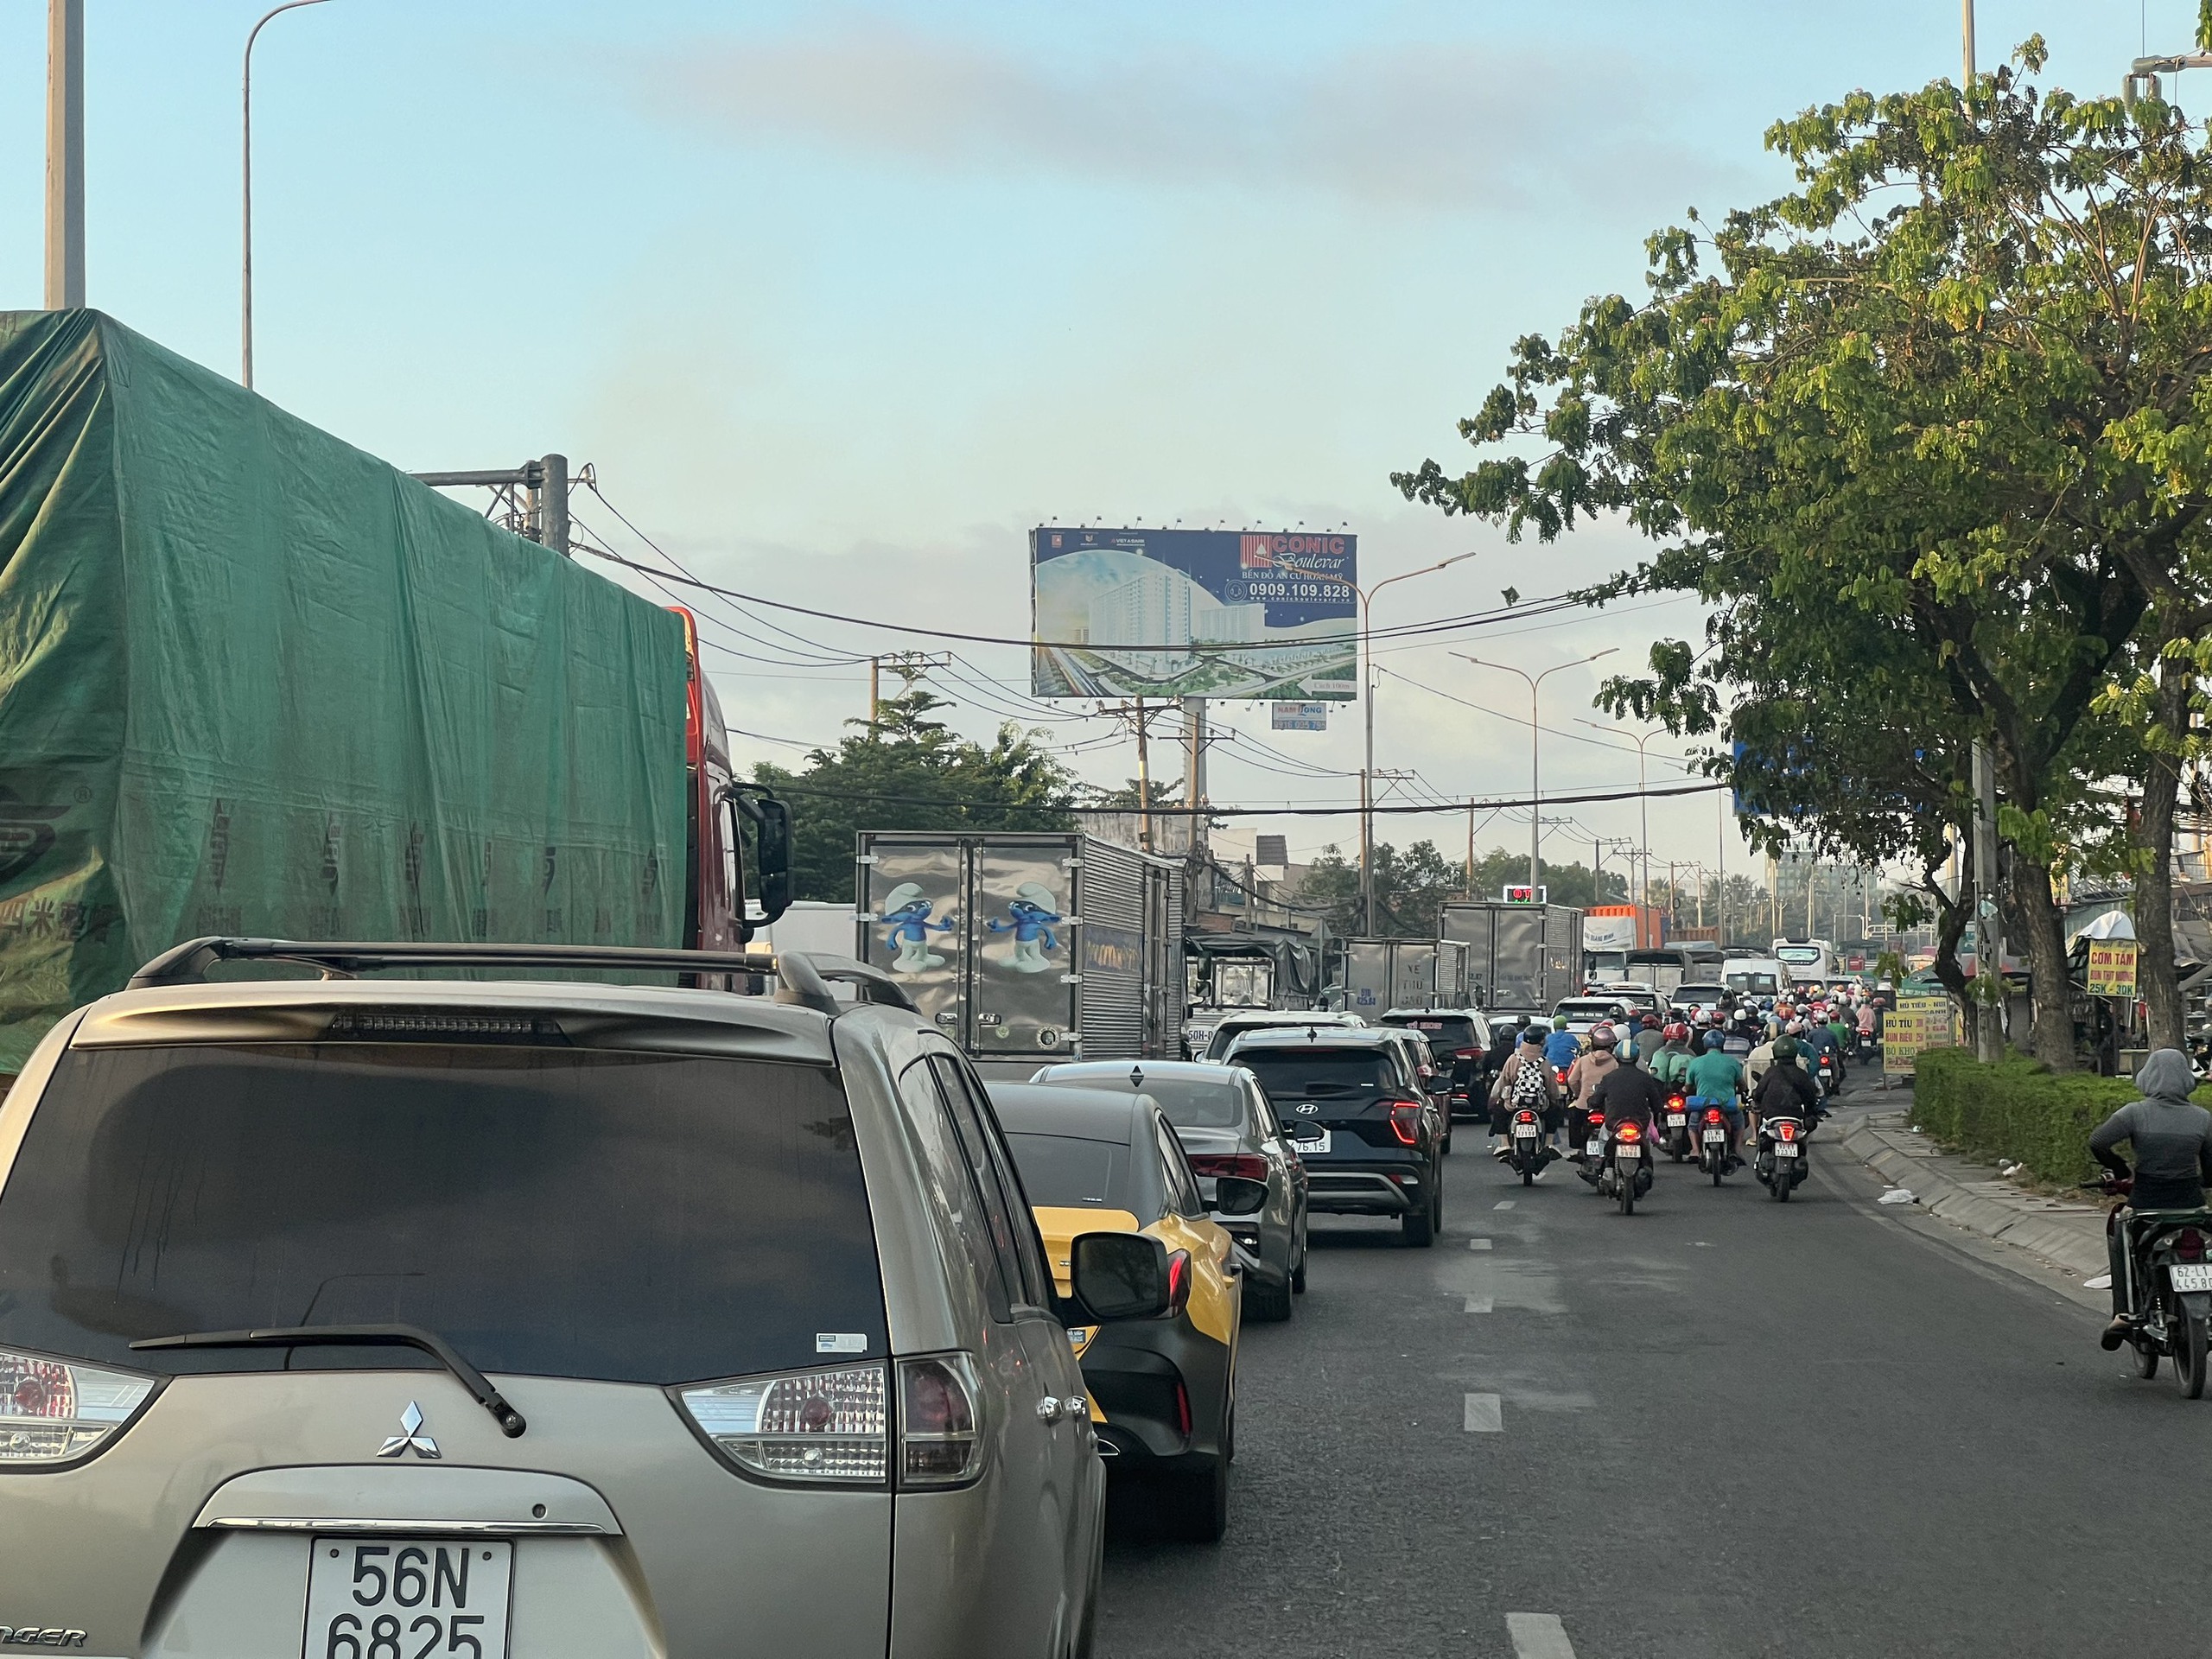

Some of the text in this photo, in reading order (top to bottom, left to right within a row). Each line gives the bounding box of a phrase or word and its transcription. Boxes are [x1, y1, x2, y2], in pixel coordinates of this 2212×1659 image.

[1272, 536, 1344, 555] CONIC
[1249, 582, 1350, 598] 0909.109.828
[2091, 951, 2112, 965] CƠM
[2089, 983, 2107, 994] 25K
[2116, 984, 2133, 995] 30K
[351, 1546, 469, 1608] 56N
[327, 1612, 486, 1659] 6825
